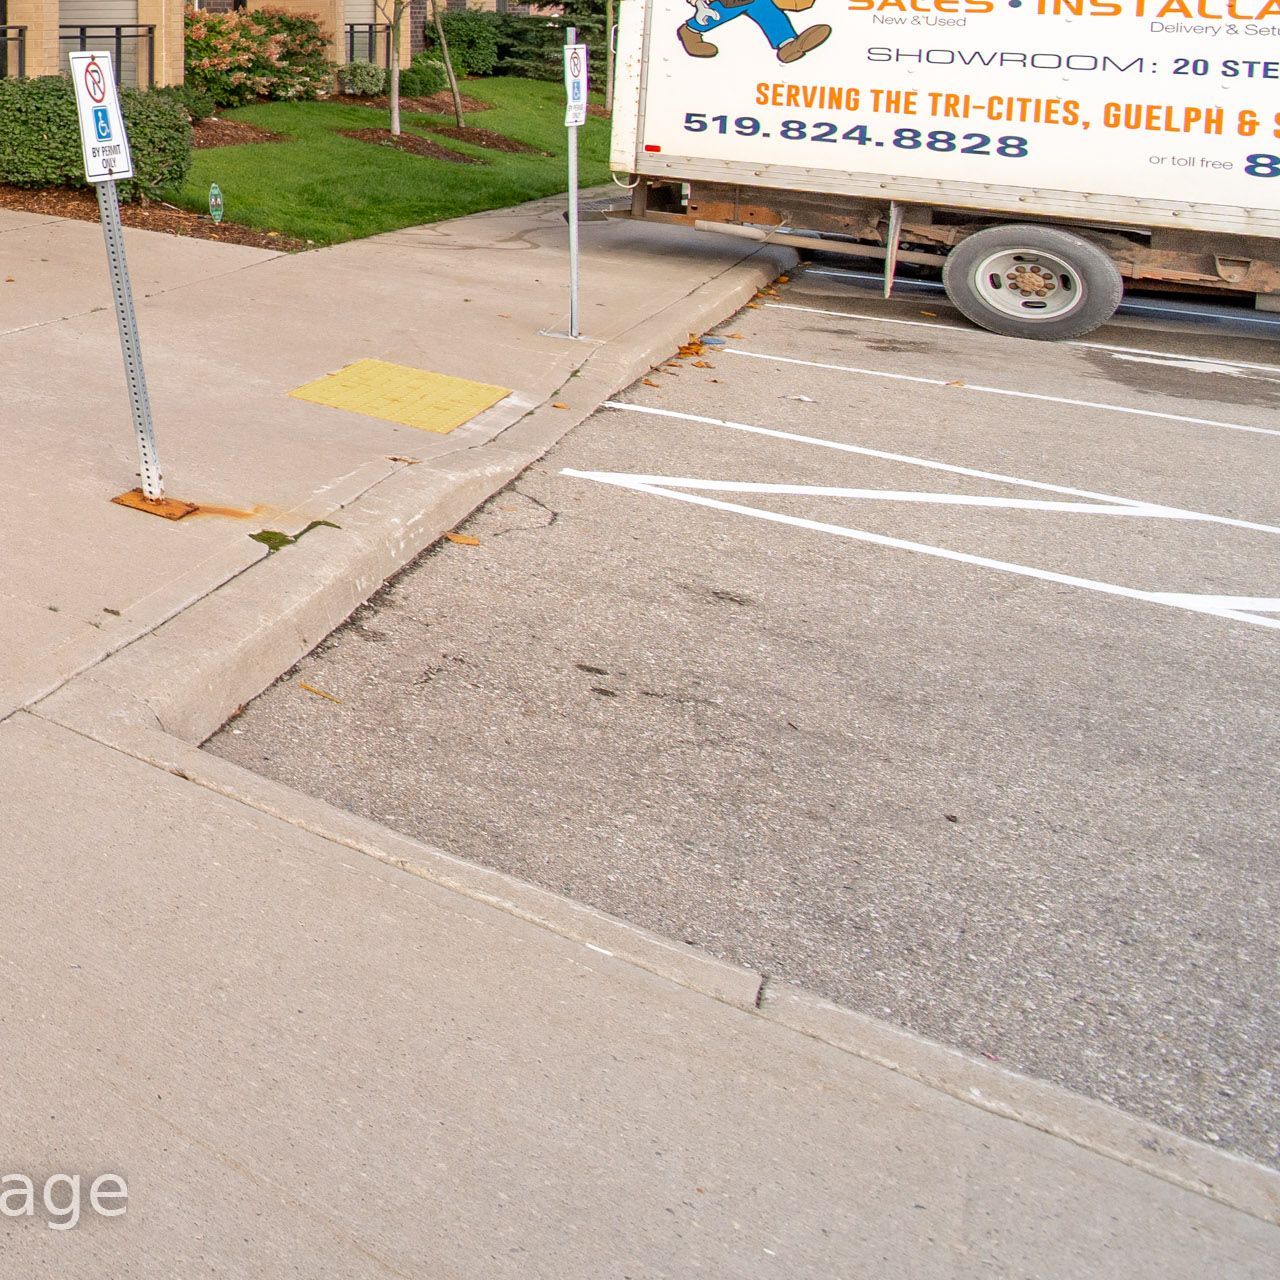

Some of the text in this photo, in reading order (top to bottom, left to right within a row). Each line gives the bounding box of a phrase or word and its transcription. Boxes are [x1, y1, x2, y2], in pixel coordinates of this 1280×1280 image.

[872, 14, 967, 27] New & Used
[1150, 21, 1280, 37] Delivery & Set
[867, 47, 1280, 79] SHOWROOM: 20 STE
[756, 82, 860, 111] SERVING
[870, 89, 918, 115] THE
[928, 91, 1091, 130] TRI-CITIES,
[1103, 102, 1224, 135] GUELPH
[1237, 109, 1260, 137] &
[91, 144, 121, 158] BY PERMIT
[102, 157, 117, 169] ONLY
[1149, 155, 1168, 165] or
[1171, 155, 1195, 168] toll
[1199, 156, 1234, 170] free
